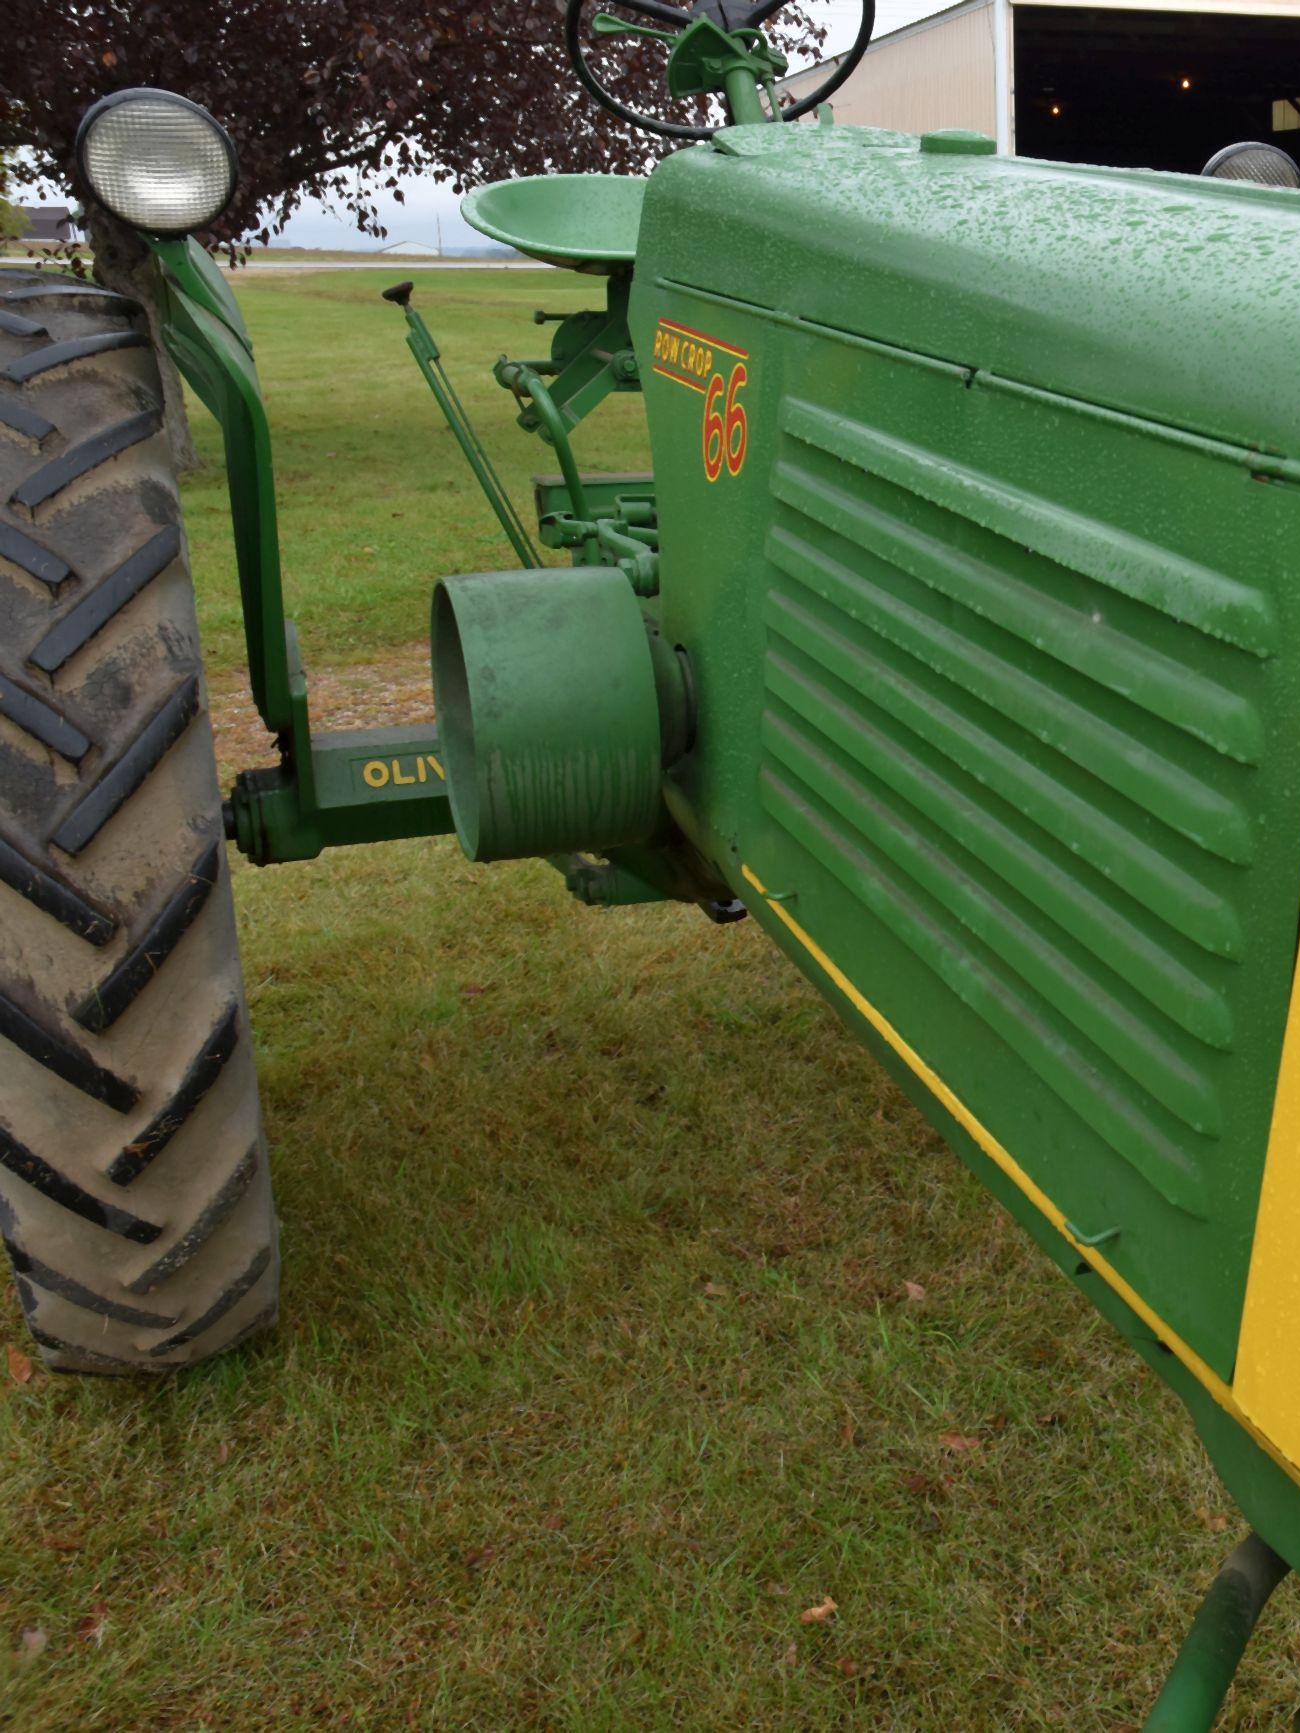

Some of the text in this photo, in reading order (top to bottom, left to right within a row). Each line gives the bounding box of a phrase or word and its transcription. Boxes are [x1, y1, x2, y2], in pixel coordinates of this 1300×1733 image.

[654, 329, 713, 379] ROW CROP
[703, 362, 748, 483] 66
[363, 755, 447, 788] OLIV
